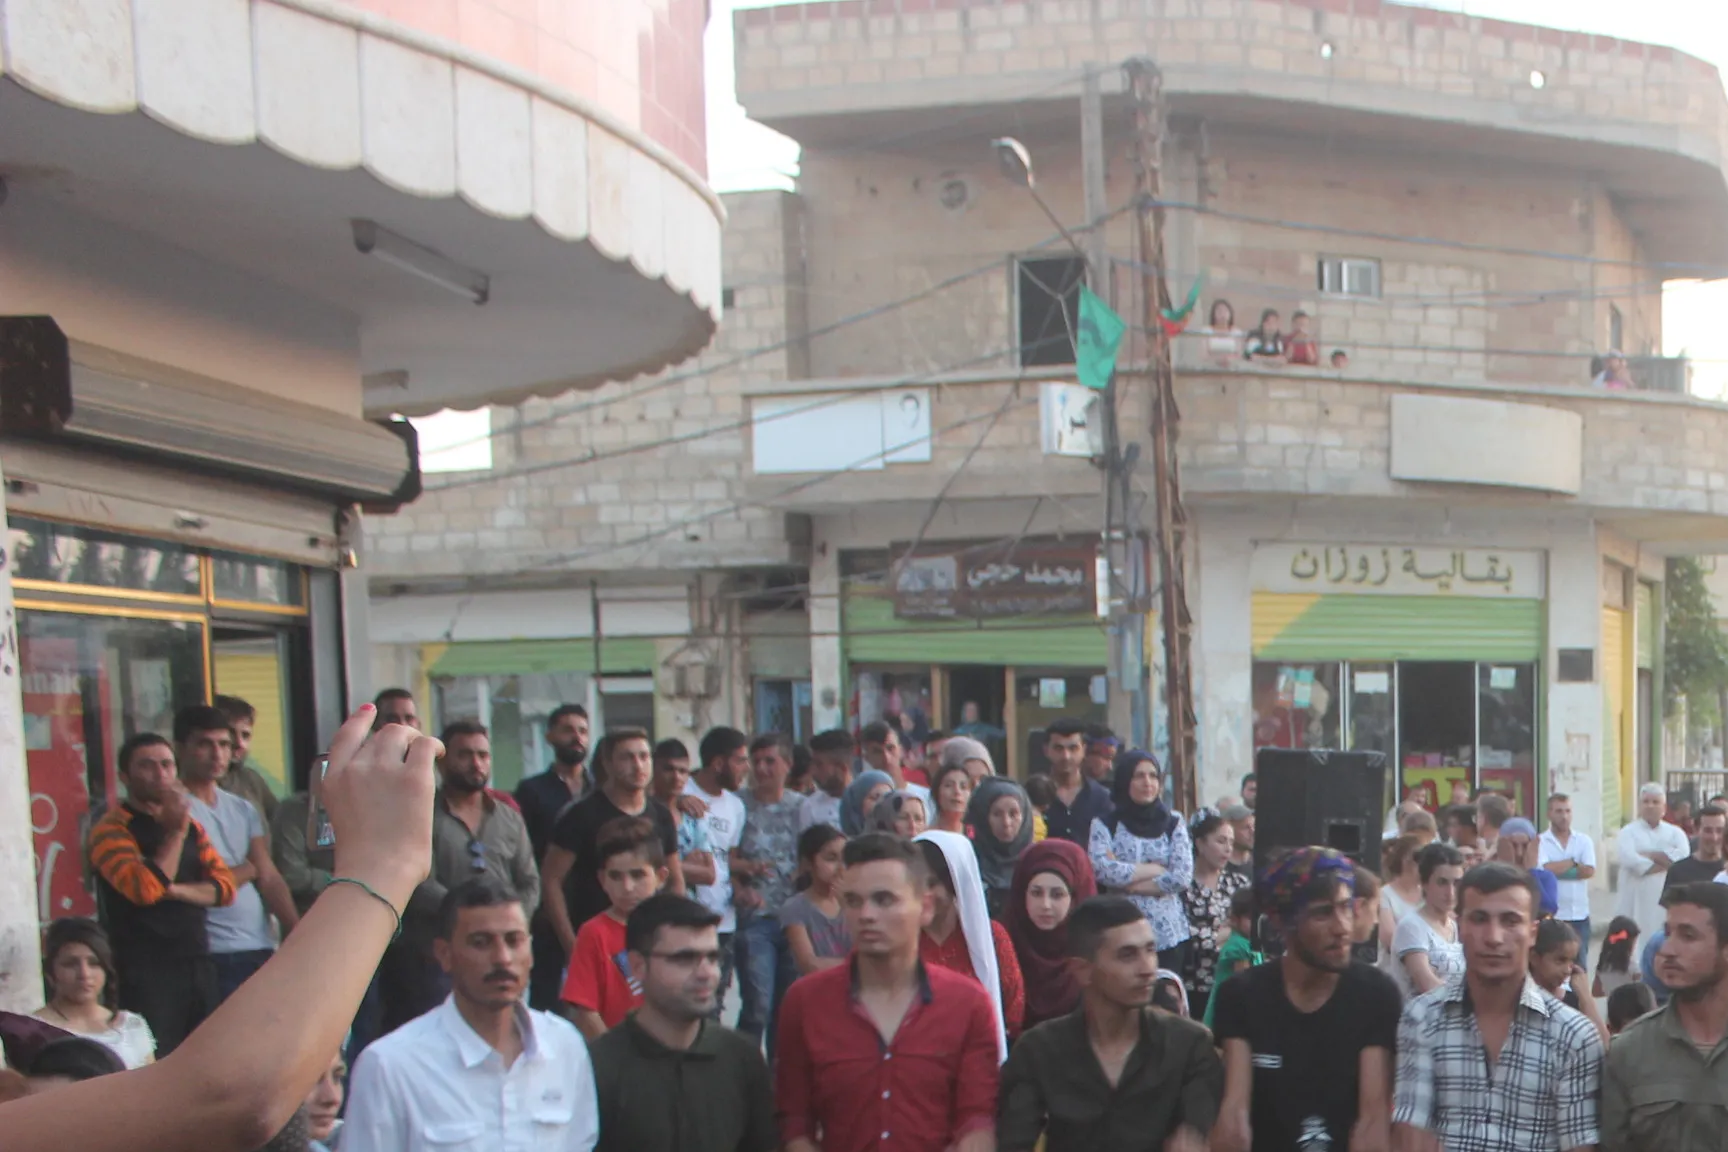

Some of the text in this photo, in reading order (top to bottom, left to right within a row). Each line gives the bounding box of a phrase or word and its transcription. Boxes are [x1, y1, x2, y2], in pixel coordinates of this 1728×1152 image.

[1024, 560, 1084, 586] محمد
[1291, 547, 1512, 592] بقالية زوزان
